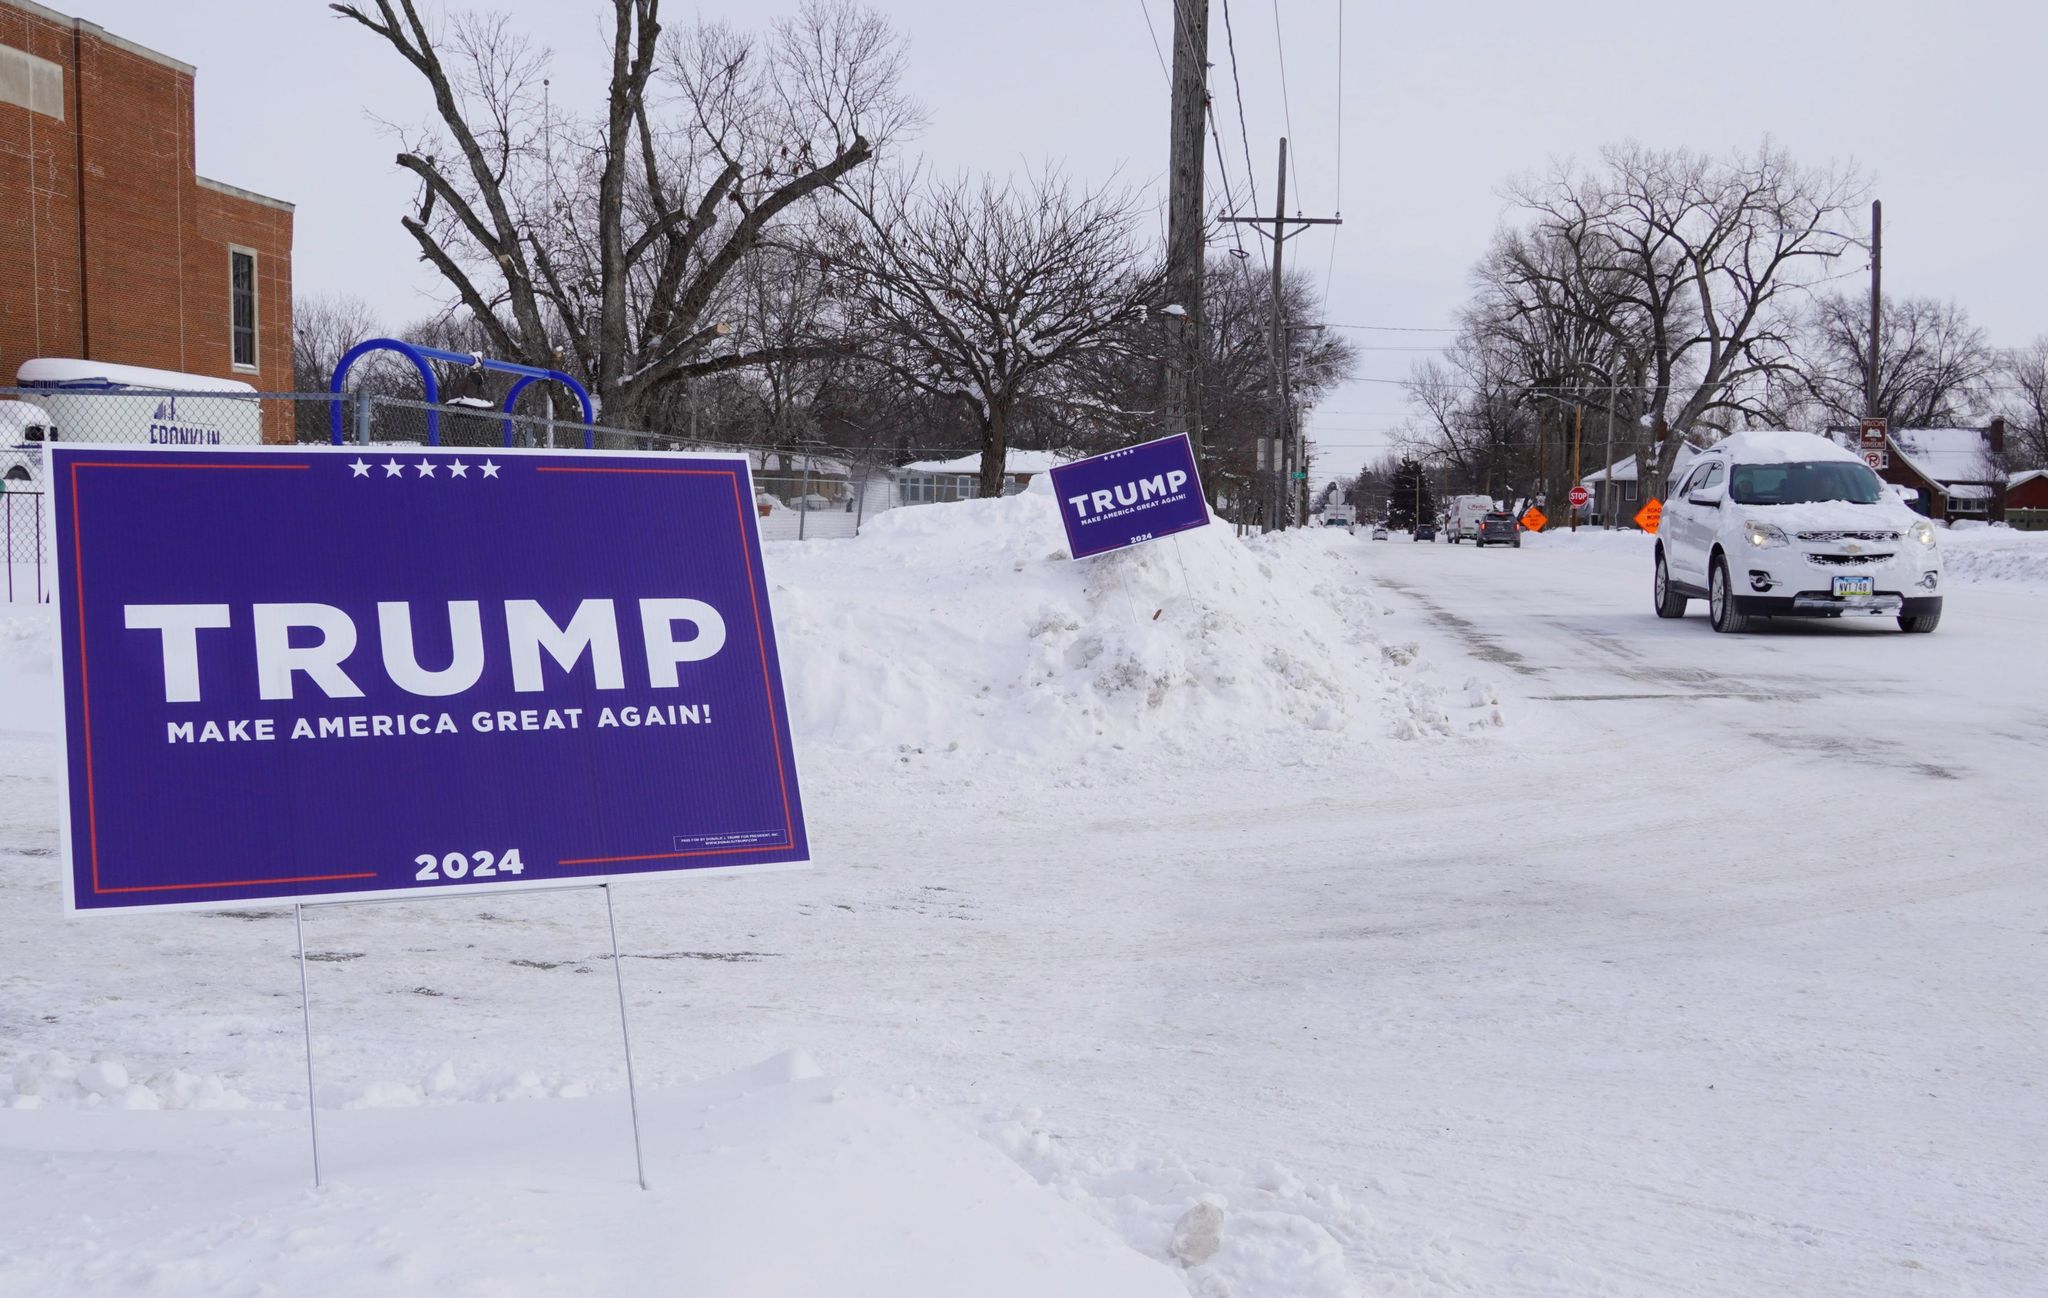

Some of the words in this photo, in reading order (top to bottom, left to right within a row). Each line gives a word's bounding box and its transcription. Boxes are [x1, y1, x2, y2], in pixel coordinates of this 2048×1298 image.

[1069, 470, 1187, 517] TRUMP
[1081, 516, 1101, 526] MAKE
[1103, 507, 1135, 520] AMERICA
[1136, 500, 1159, 511] GREAT
[1161, 493, 1187, 504] AGAIN!
[1571, 492, 1587, 500] STOP
[1130, 532, 1153, 544] 2024
[1840, 583, 1851, 591] NVT
[1854, 583, 1867, 591] 748
[124, 598, 726, 703] TRUMP
[168, 718, 276, 743] MAKE
[291, 713, 459, 739] AMERICA
[472, 708, 583, 733] GREAT
[598, 705, 712, 728] AGAIN!
[415, 849, 525, 880] 2024
